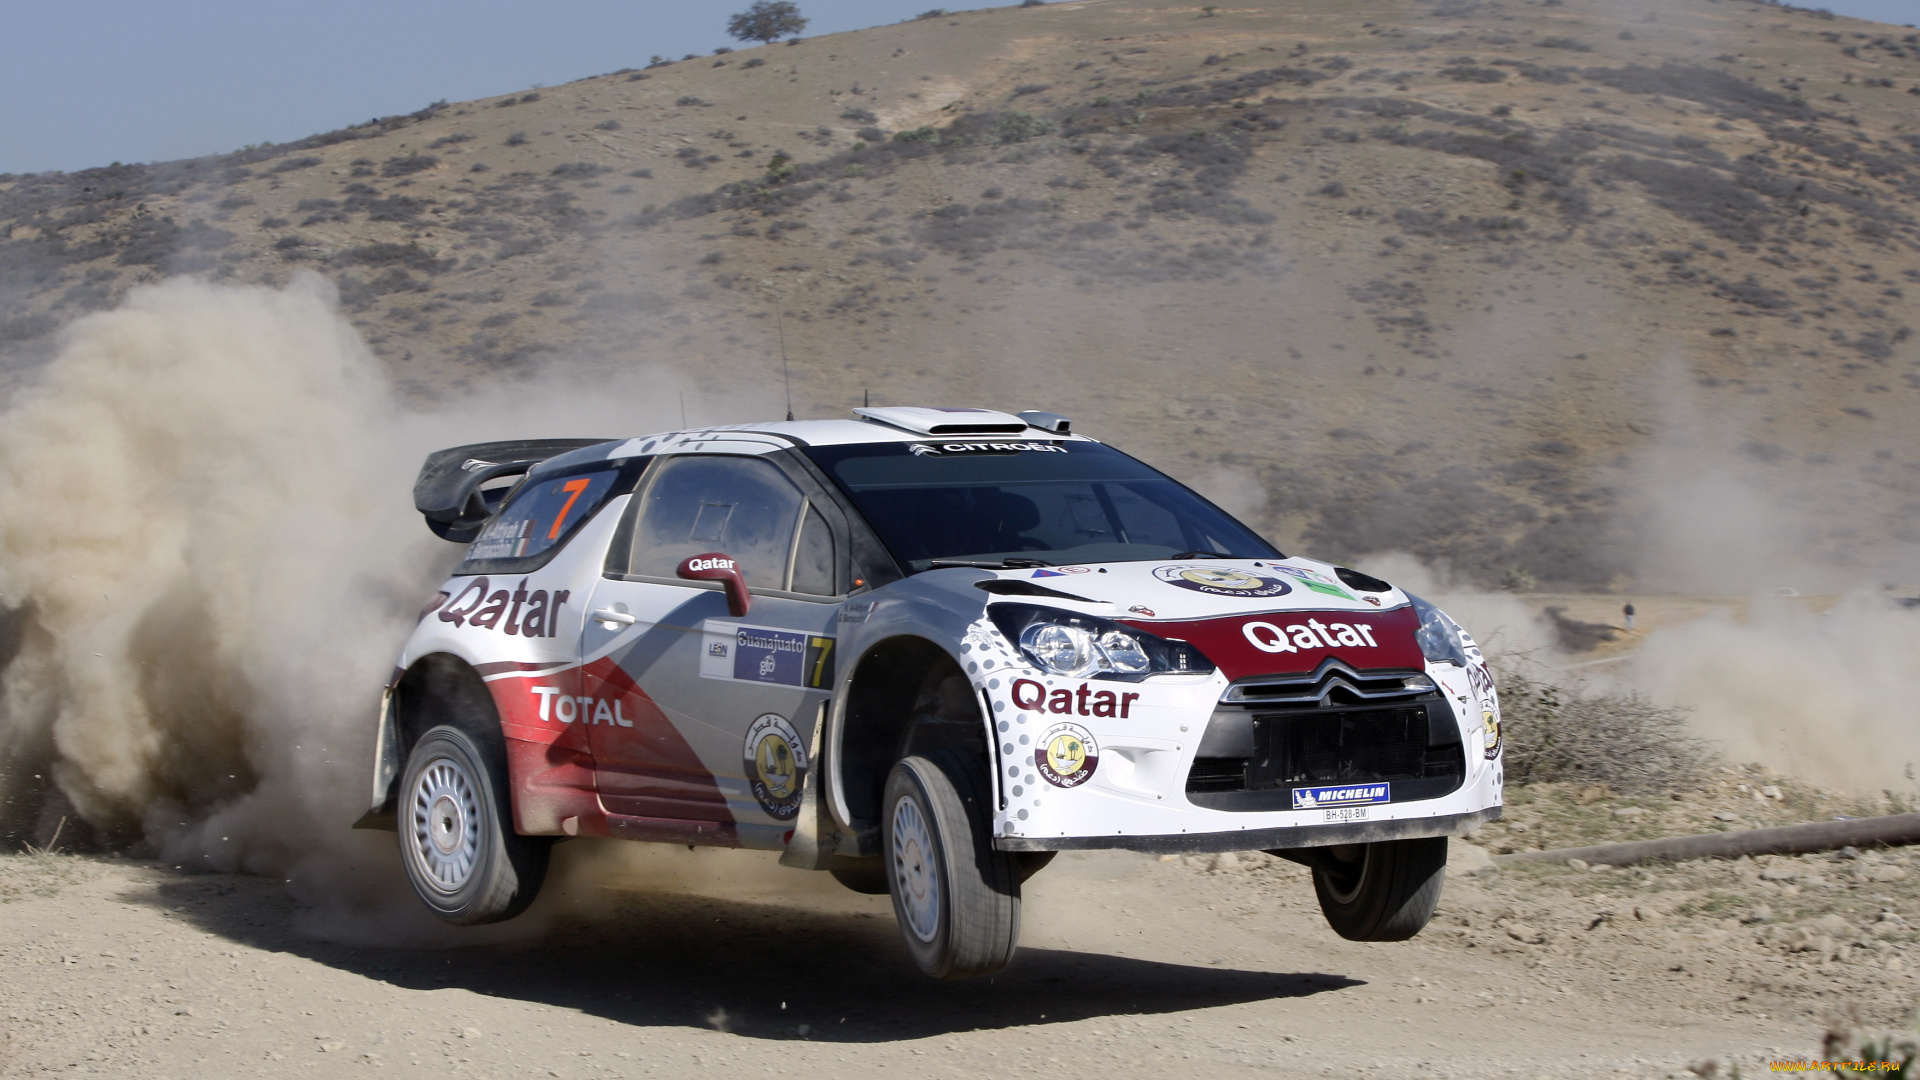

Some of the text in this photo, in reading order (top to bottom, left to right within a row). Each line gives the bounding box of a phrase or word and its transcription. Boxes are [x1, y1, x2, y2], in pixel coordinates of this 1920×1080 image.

[548, 478, 591, 539] 7
[689, 557, 735, 571] Qatar
[438, 576, 570, 637] Qatar
[738, 631, 803, 654] Guanajuato
[1242, 617, 1378, 653] Qatar
[812, 637, 833, 687] 7
[532, 686, 633, 727] TOTAL
[1011, 678, 1140, 719] Qatar
[1318, 786, 1386, 802] MICHELIN
[1326, 808, 1367, 820] BH-528-BM
